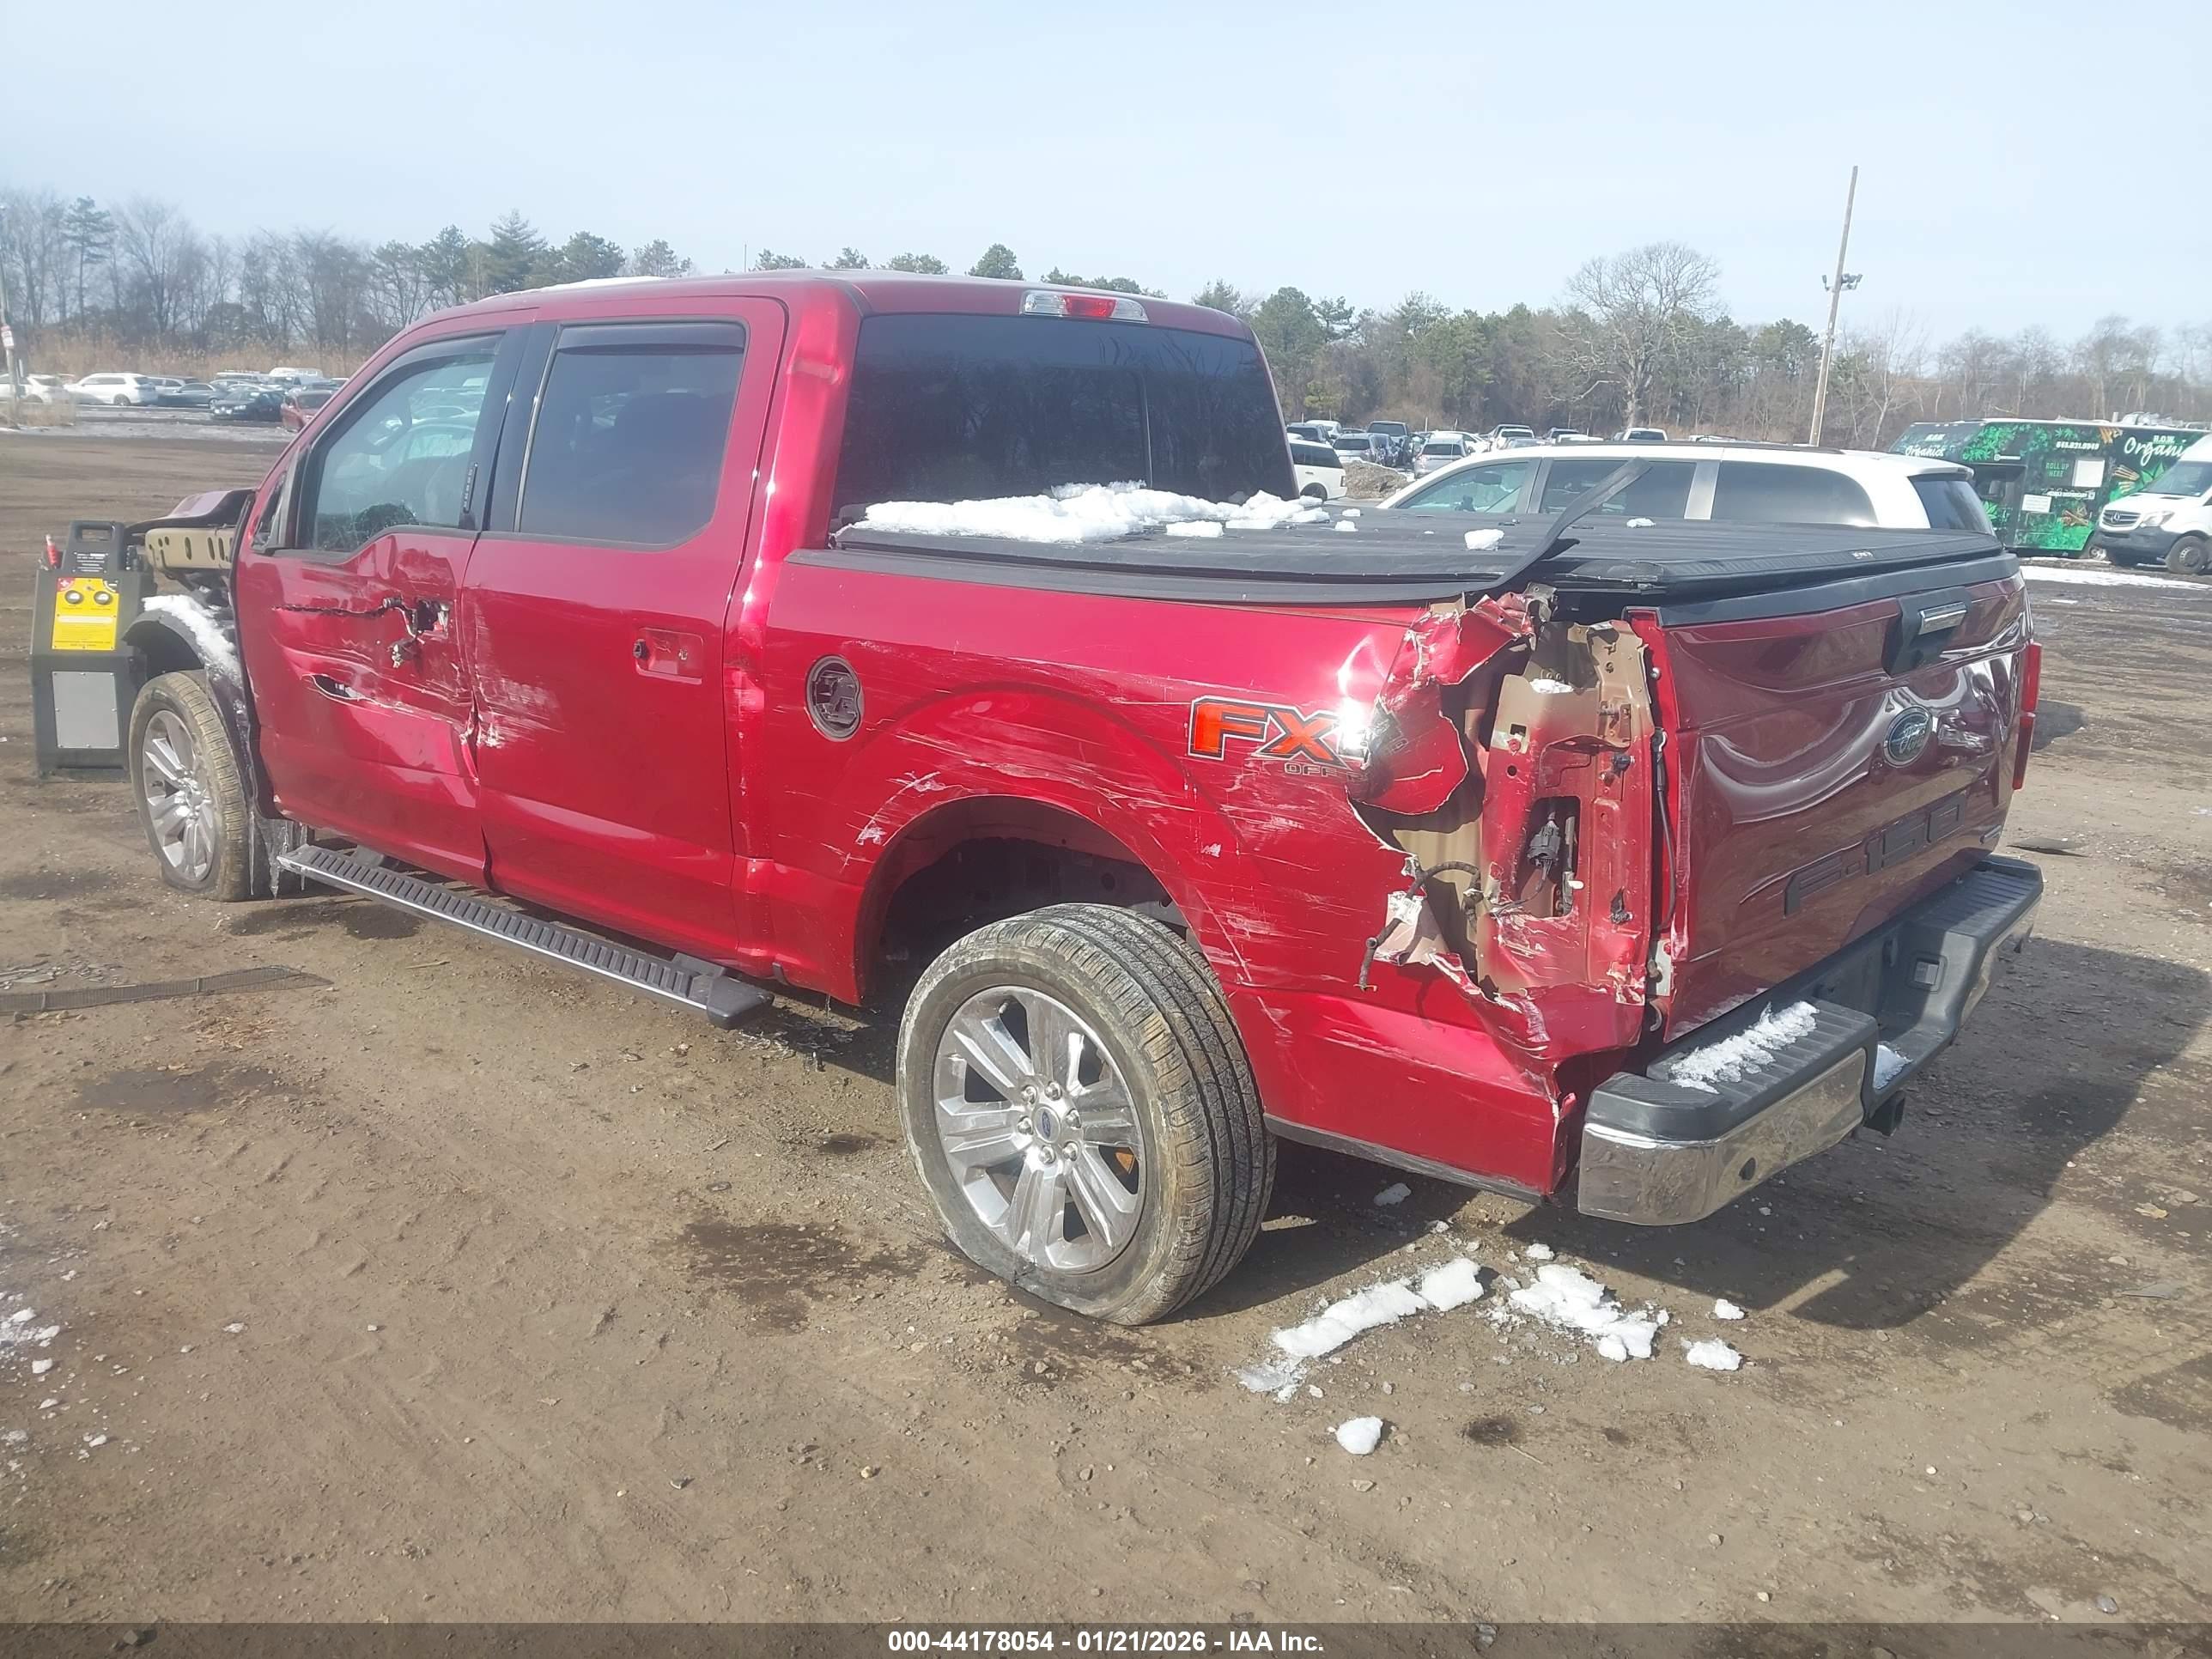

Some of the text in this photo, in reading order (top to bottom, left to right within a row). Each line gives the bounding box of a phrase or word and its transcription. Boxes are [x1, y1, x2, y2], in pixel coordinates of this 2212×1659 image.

[2124, 436, 2187, 467] Organi
[1188, 695, 1403, 771] FX
[1784, 793, 1966, 917] F-150
